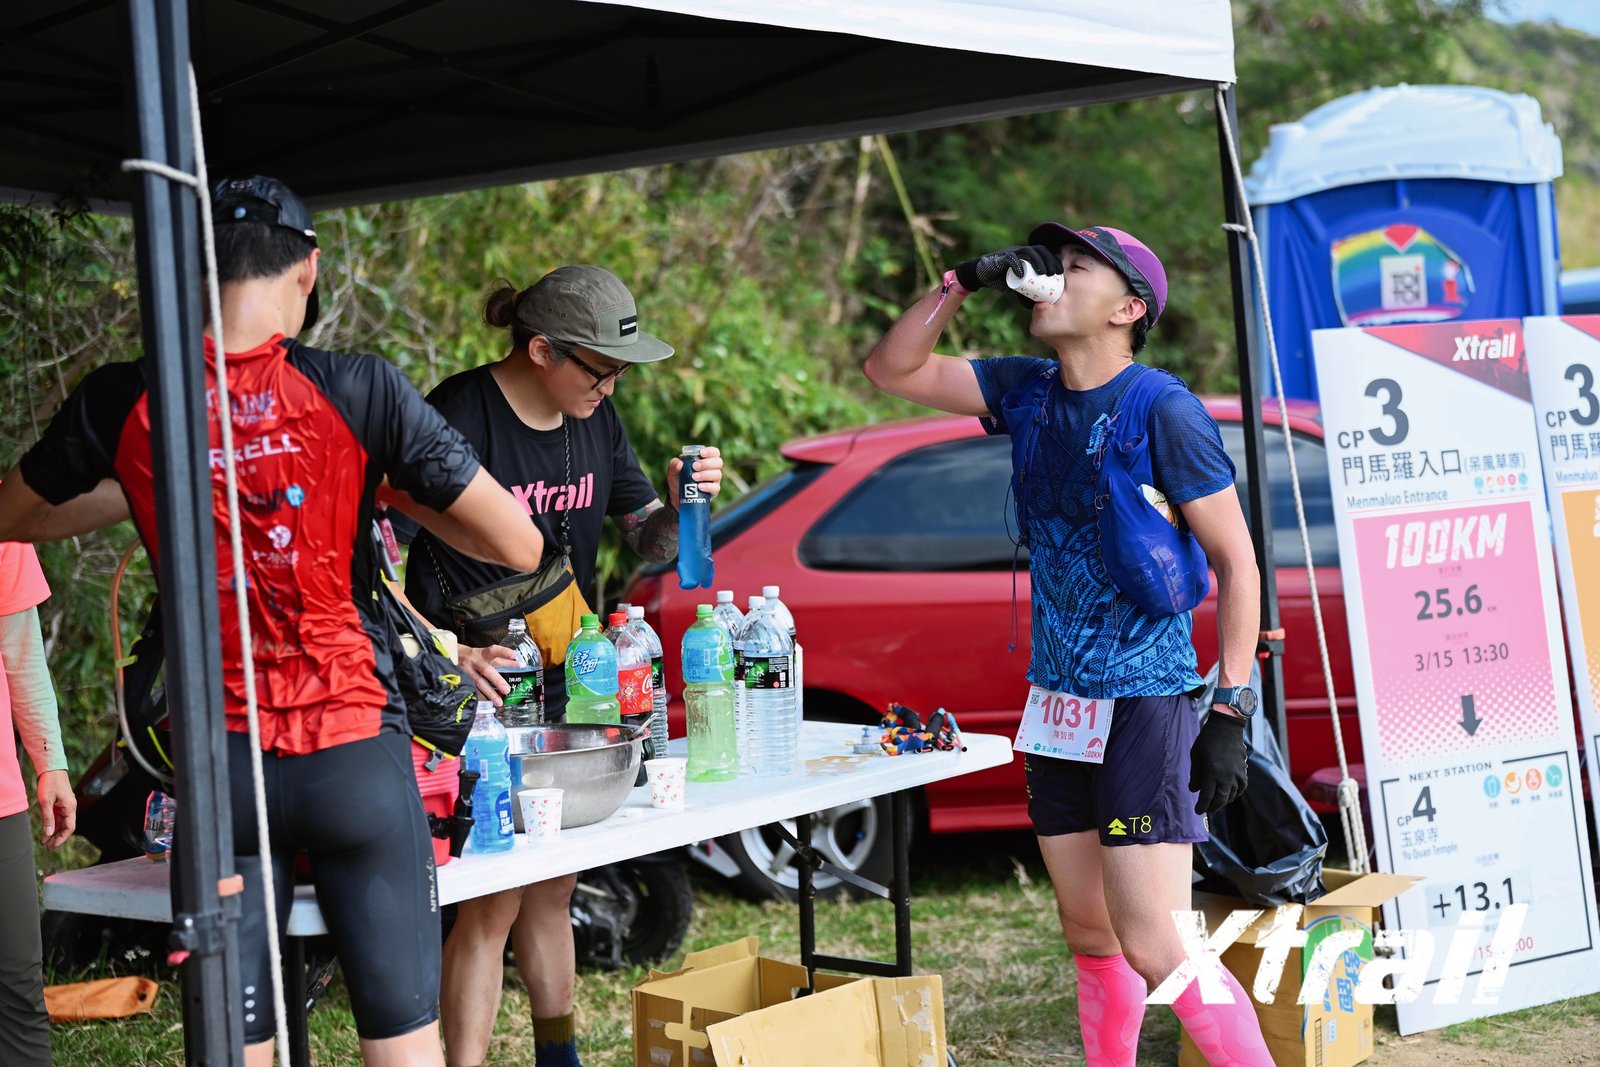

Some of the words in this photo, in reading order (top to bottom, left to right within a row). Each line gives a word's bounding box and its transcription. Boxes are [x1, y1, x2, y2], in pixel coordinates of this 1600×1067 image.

[1452, 333, 1516, 362] Xtrail
[1337, 430, 1365, 449] CP
[1364, 378, 1410, 446] 3
[1545, 410, 1567, 428] CP
[1564, 363, 1600, 426] 3
[1341, 449, 1462, 486] 門馬羅入口
[1346, 492, 1402, 510] Menmaluo
[1403, 489, 1449, 504] Entrance
[1385, 513, 1507, 569] 100KM
[1414, 584, 1483, 621] 25.6
[1414, 650, 1454, 672] 3/15
[1461, 642, 1510, 666] 13:30
[1040, 695, 1098, 730] 1031
[1409, 771, 1441, 783] NEXT
[1444, 762, 1493, 778] STATION
[1128, 815, 1152, 834] T8
[1397, 814, 1412, 827] CP
[1412, 786, 1437, 823] 4
[1433, 877, 1515, 918] +13.1
